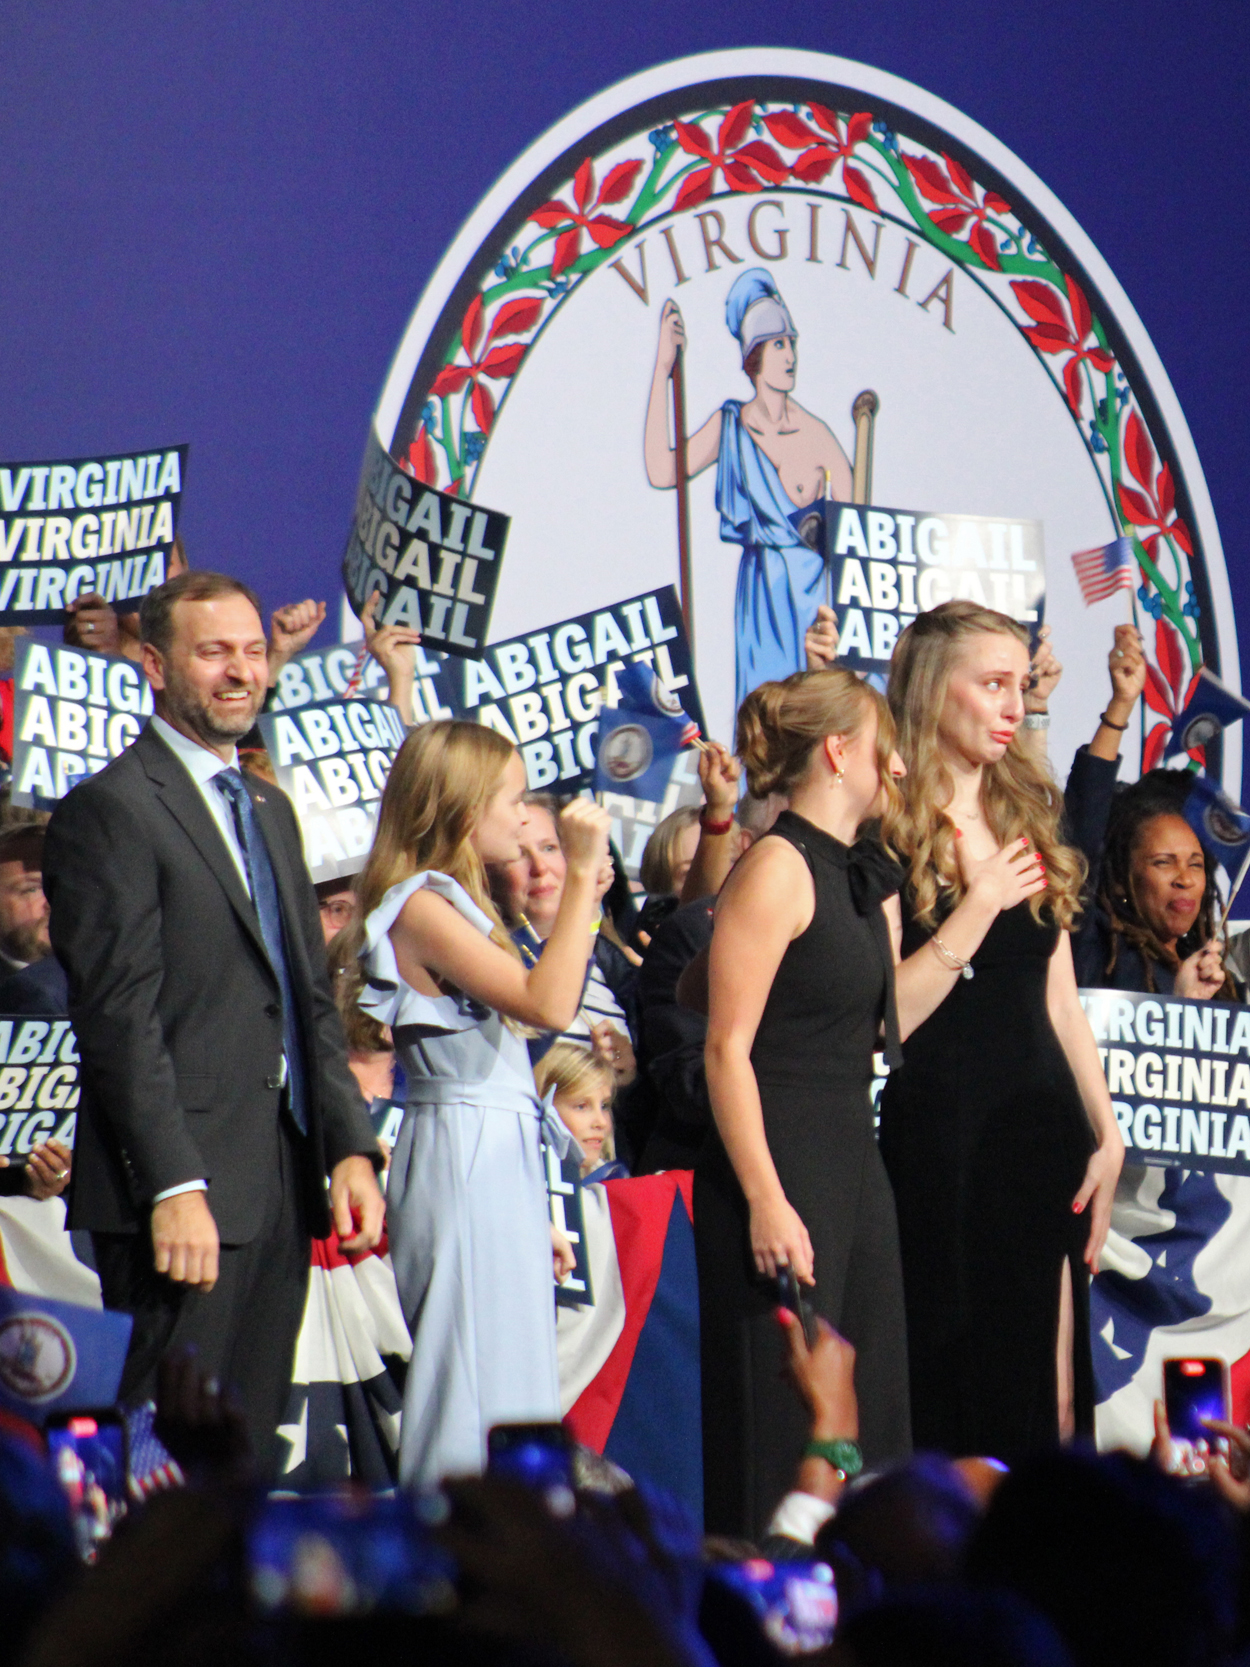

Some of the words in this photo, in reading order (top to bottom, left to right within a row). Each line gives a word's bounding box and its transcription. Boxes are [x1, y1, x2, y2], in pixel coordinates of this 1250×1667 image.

[608, 200, 955, 334] VIRGINIA
[0, 451, 181, 511] VIRGINIA
[0, 501, 173, 562] VIRGINIA
[834, 508, 1037, 572] ABIGAIL
[465, 596, 679, 708] ABIGAIL
